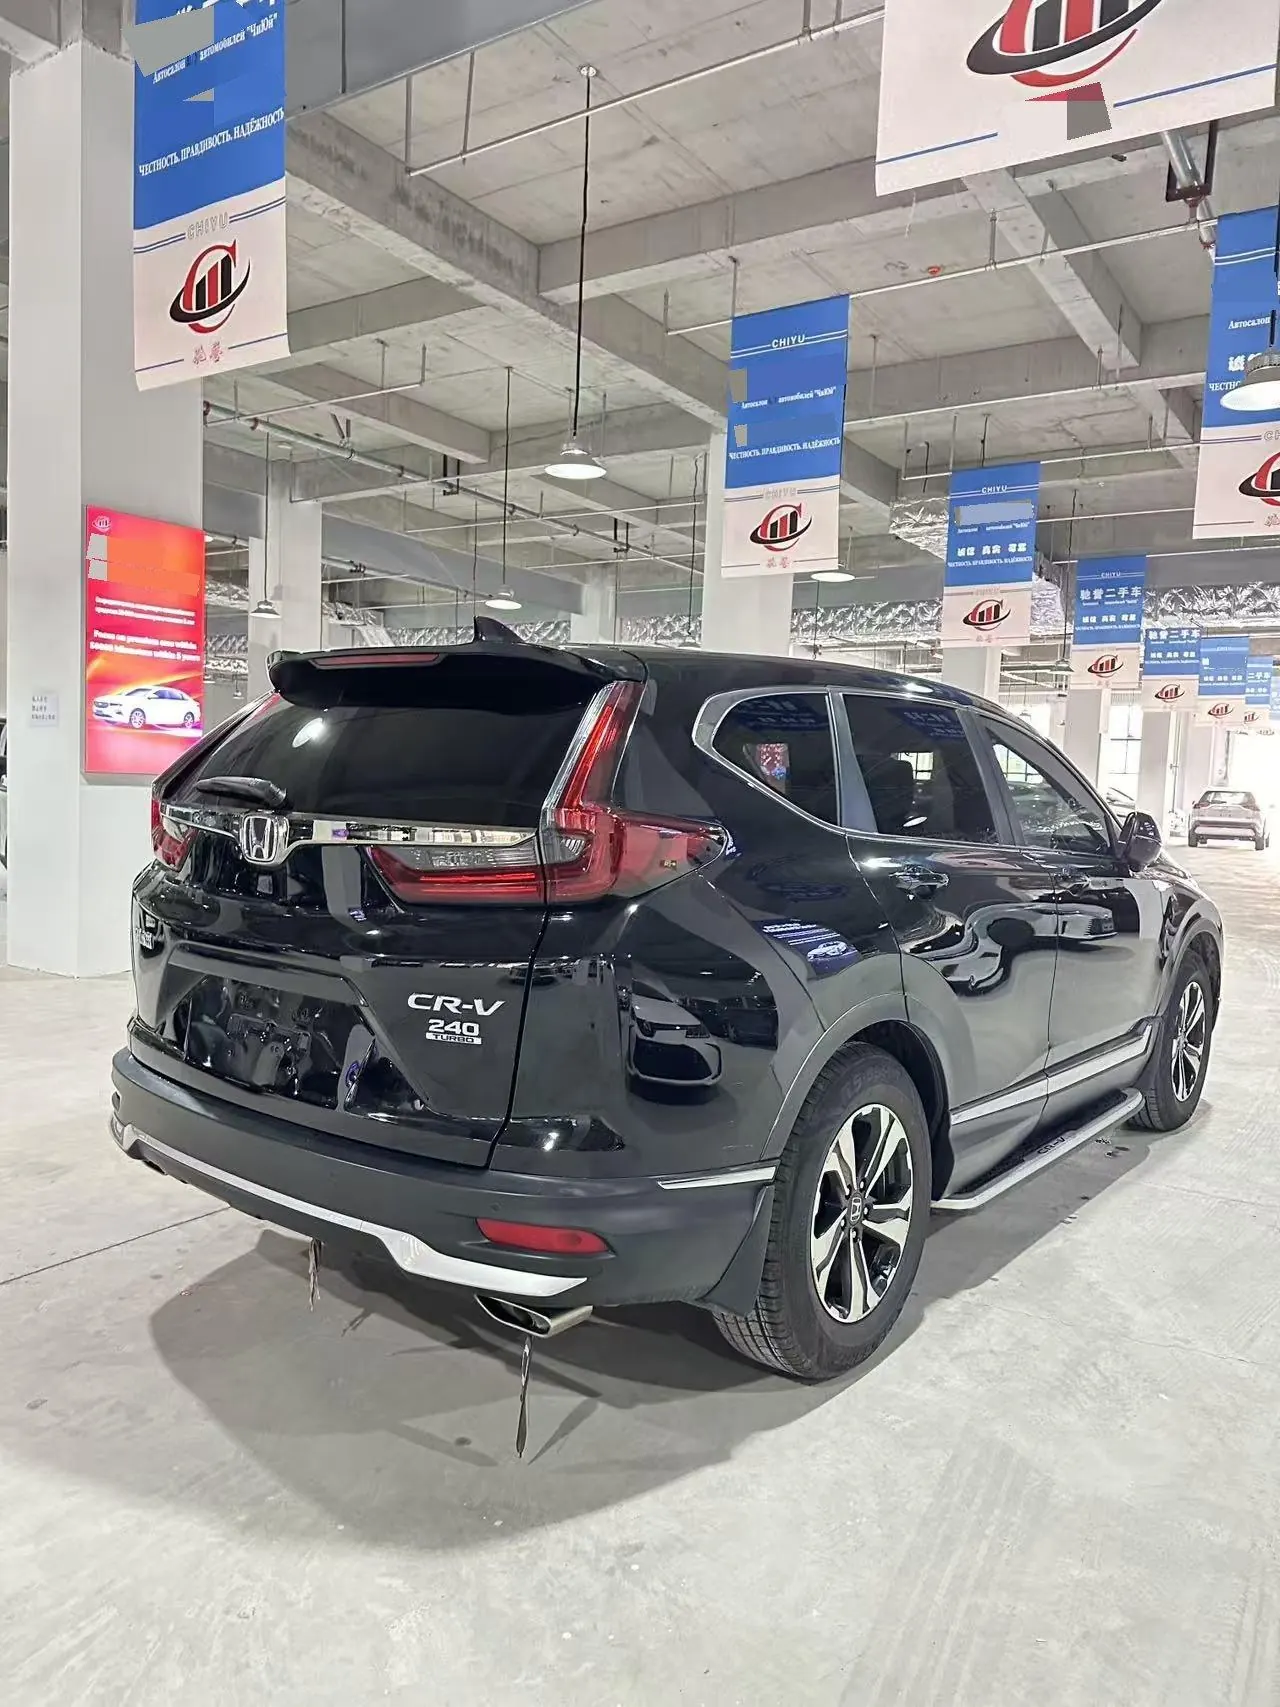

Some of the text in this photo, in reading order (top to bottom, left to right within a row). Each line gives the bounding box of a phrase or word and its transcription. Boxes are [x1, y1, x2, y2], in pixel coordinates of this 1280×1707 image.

[187, 211, 229, 240] CHIYU
[771, 334, 806, 349] CHIYU
[981, 484, 1009, 494] CHIYU
[407, 992, 506, 1016] CR-V
[428, 1018, 480, 1036] 240
[432, 1033, 475, 1043] TURBO
